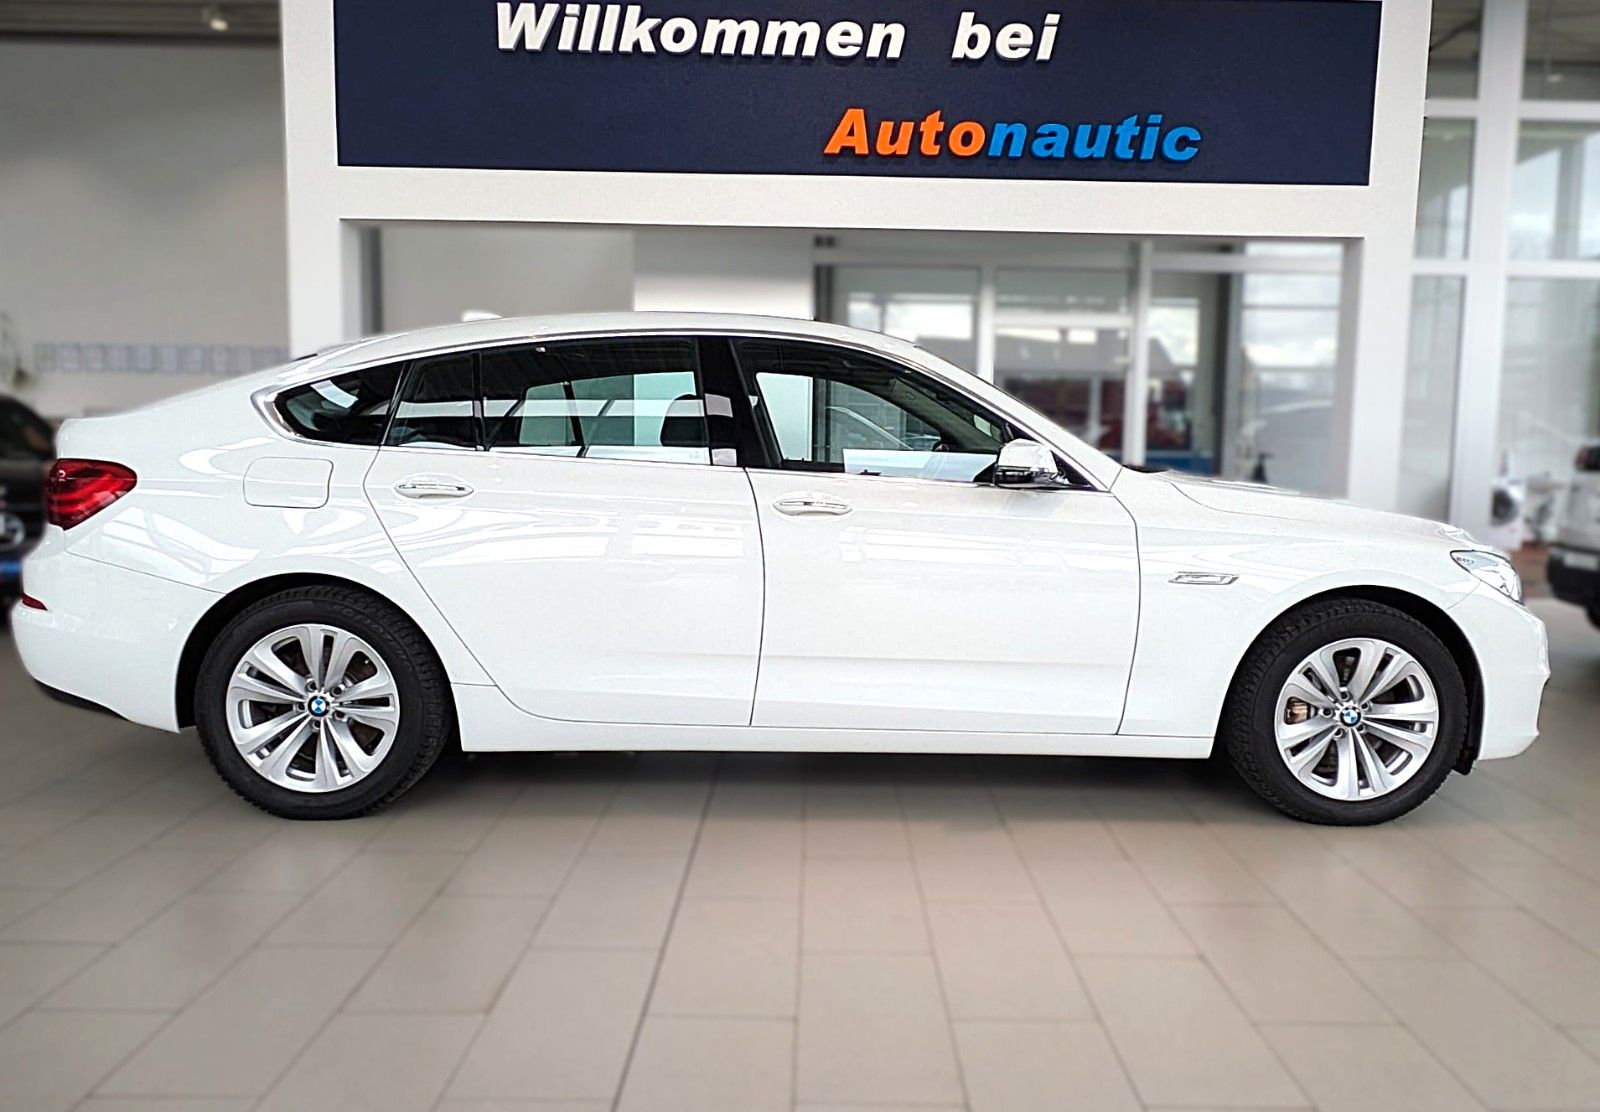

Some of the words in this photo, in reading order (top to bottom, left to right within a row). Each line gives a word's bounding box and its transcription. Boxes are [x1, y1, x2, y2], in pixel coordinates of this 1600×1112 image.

[496, 2, 906, 59] Willkommen
[951, 11, 1061, 62] bei
[824, 108, 1203, 162] Autonautic
